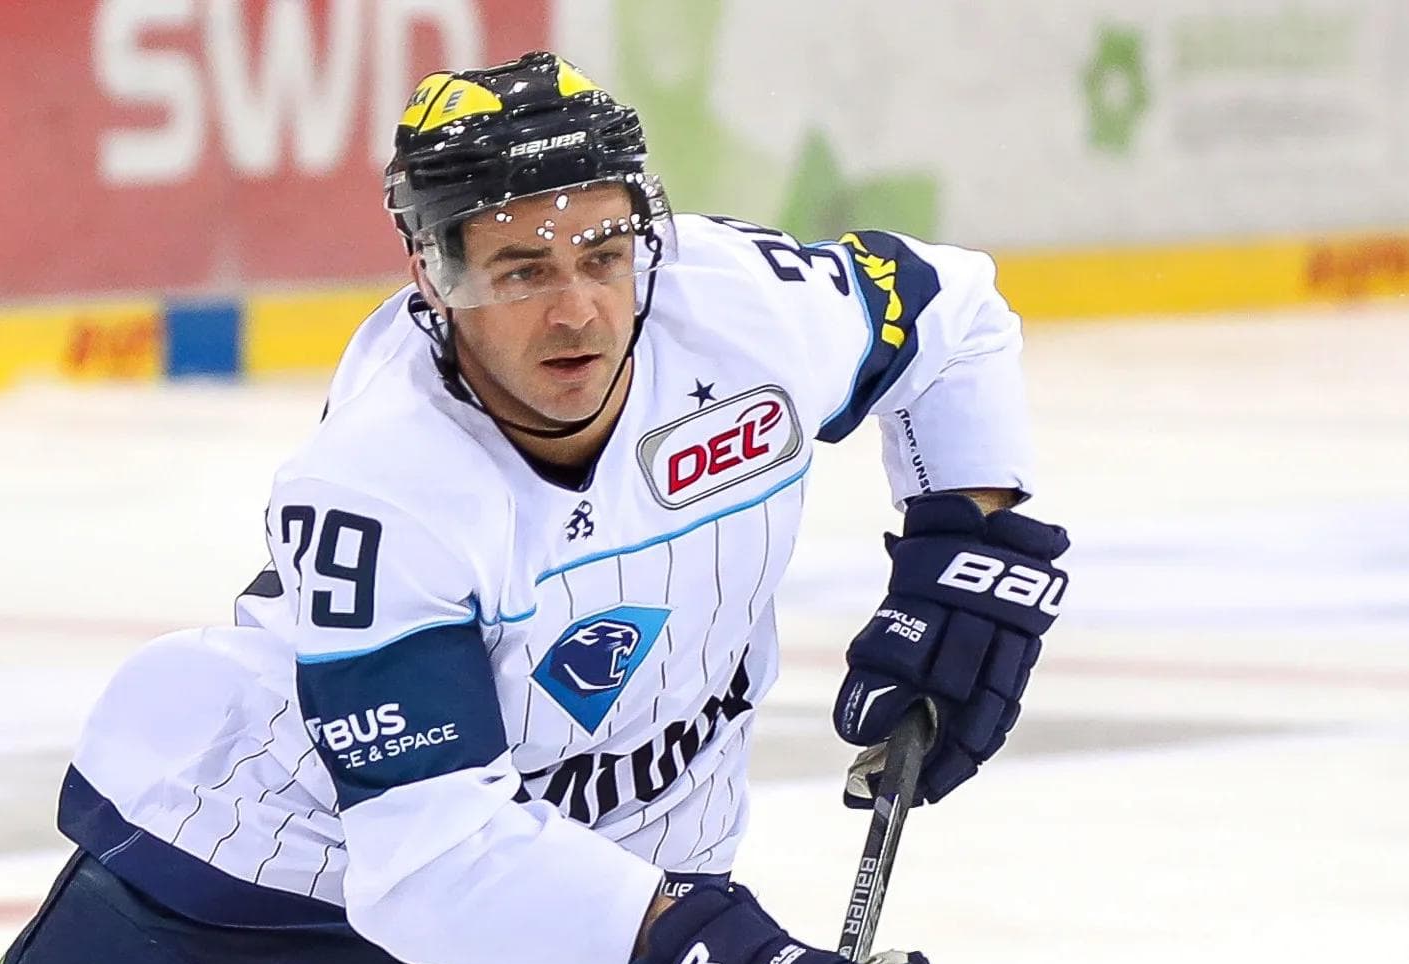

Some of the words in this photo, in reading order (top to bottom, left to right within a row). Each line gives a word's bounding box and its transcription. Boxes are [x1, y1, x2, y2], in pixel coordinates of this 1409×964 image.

[510, 131, 587, 158] BAUER
[668, 409, 779, 496] DEL
[368, 740, 384, 761] &
[385, 722, 460, 758] SPACE
[843, 856, 878, 936] BAUER
